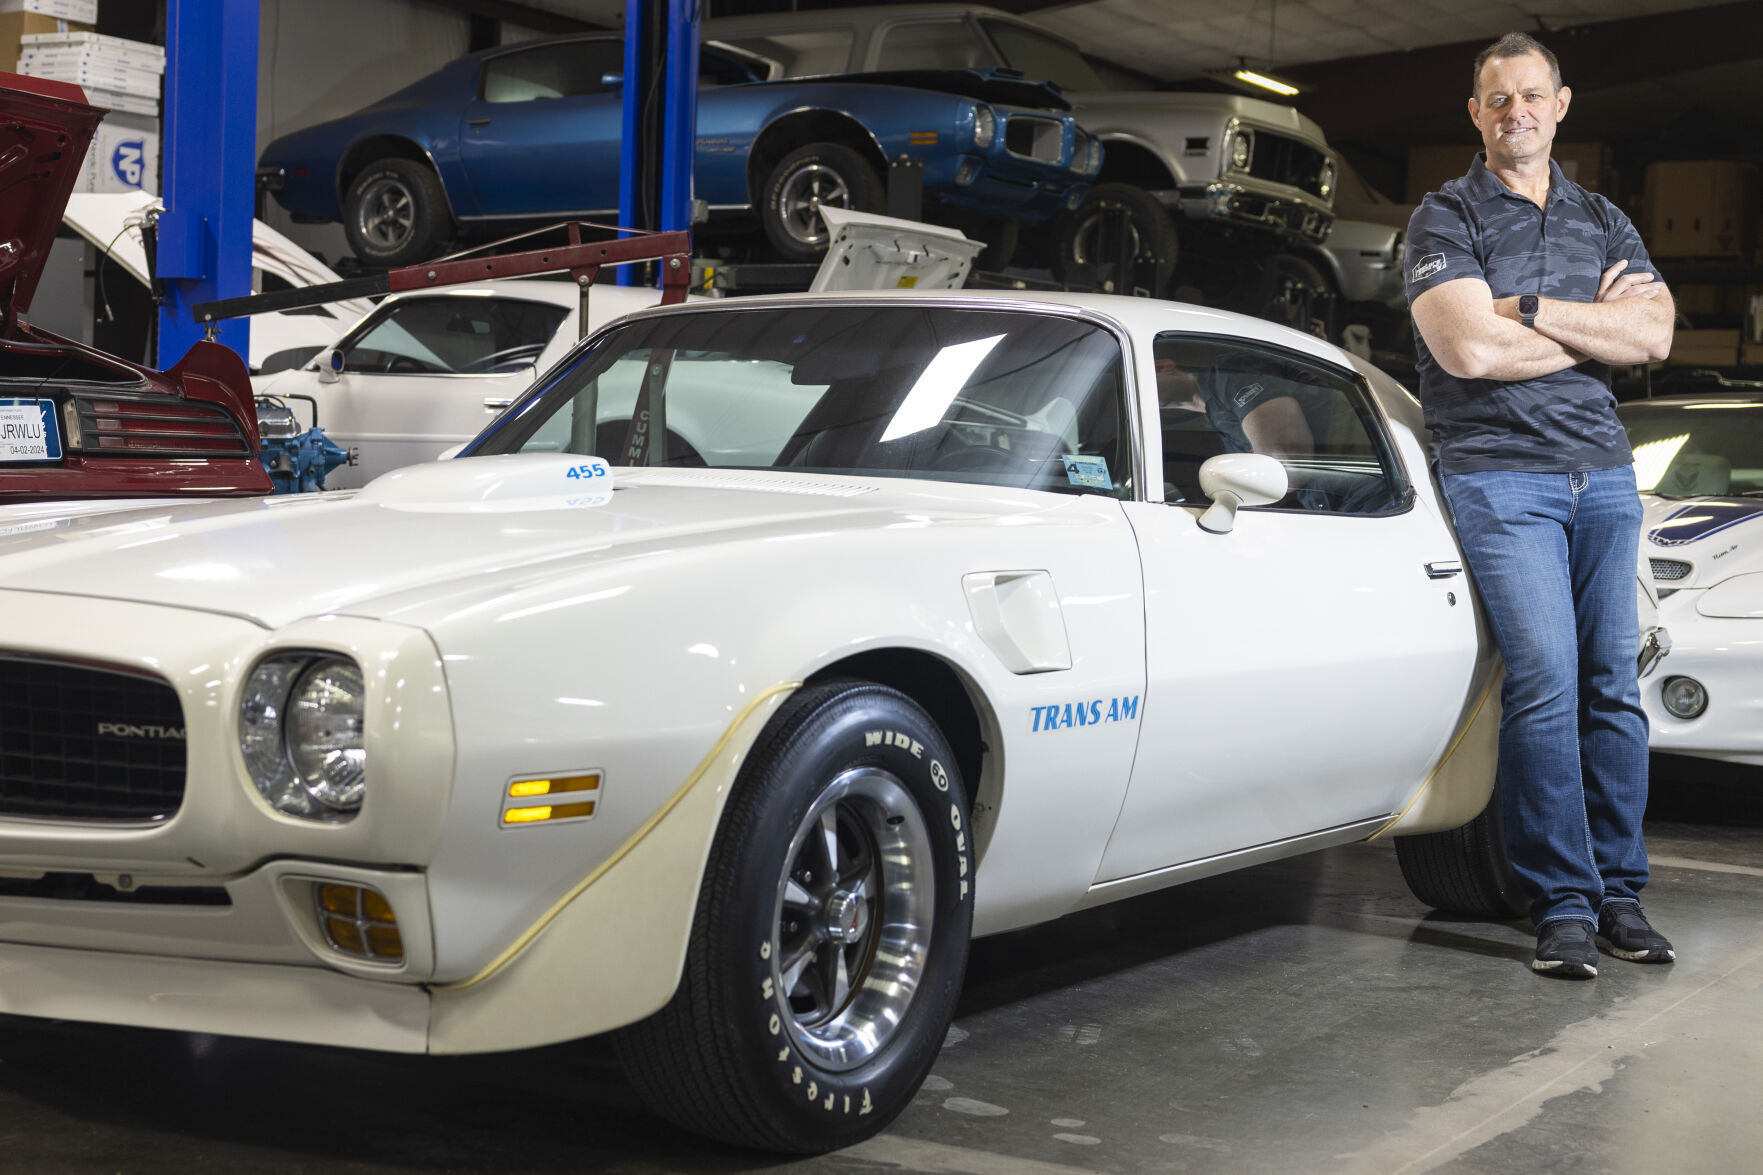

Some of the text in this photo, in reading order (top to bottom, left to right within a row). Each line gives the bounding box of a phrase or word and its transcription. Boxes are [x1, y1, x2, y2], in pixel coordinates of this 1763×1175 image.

[119, 146, 141, 184] NP
[10, 446, 45, 454] 04-02-2024
[566, 463, 606, 480] 455
[1031, 695, 1139, 732] TRANS AM
[865, 731, 925, 760] WIDE
[951, 803, 969, 901] OVAL
